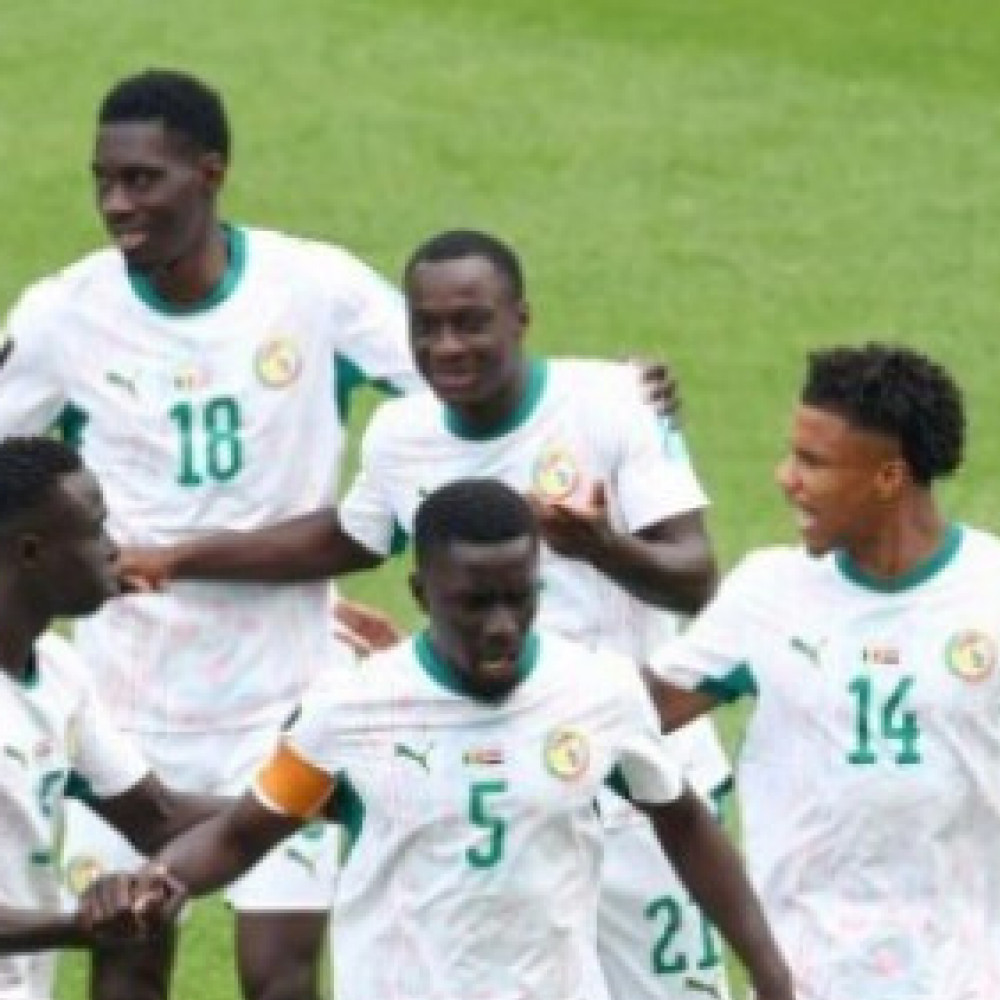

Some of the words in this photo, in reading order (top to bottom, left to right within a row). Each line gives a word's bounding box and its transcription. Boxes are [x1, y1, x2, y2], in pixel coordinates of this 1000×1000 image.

[168, 396, 243, 486] 18
[846, 674, 922, 765] 14
[465, 779, 507, 869] 5
[643, 896, 720, 974] 21
